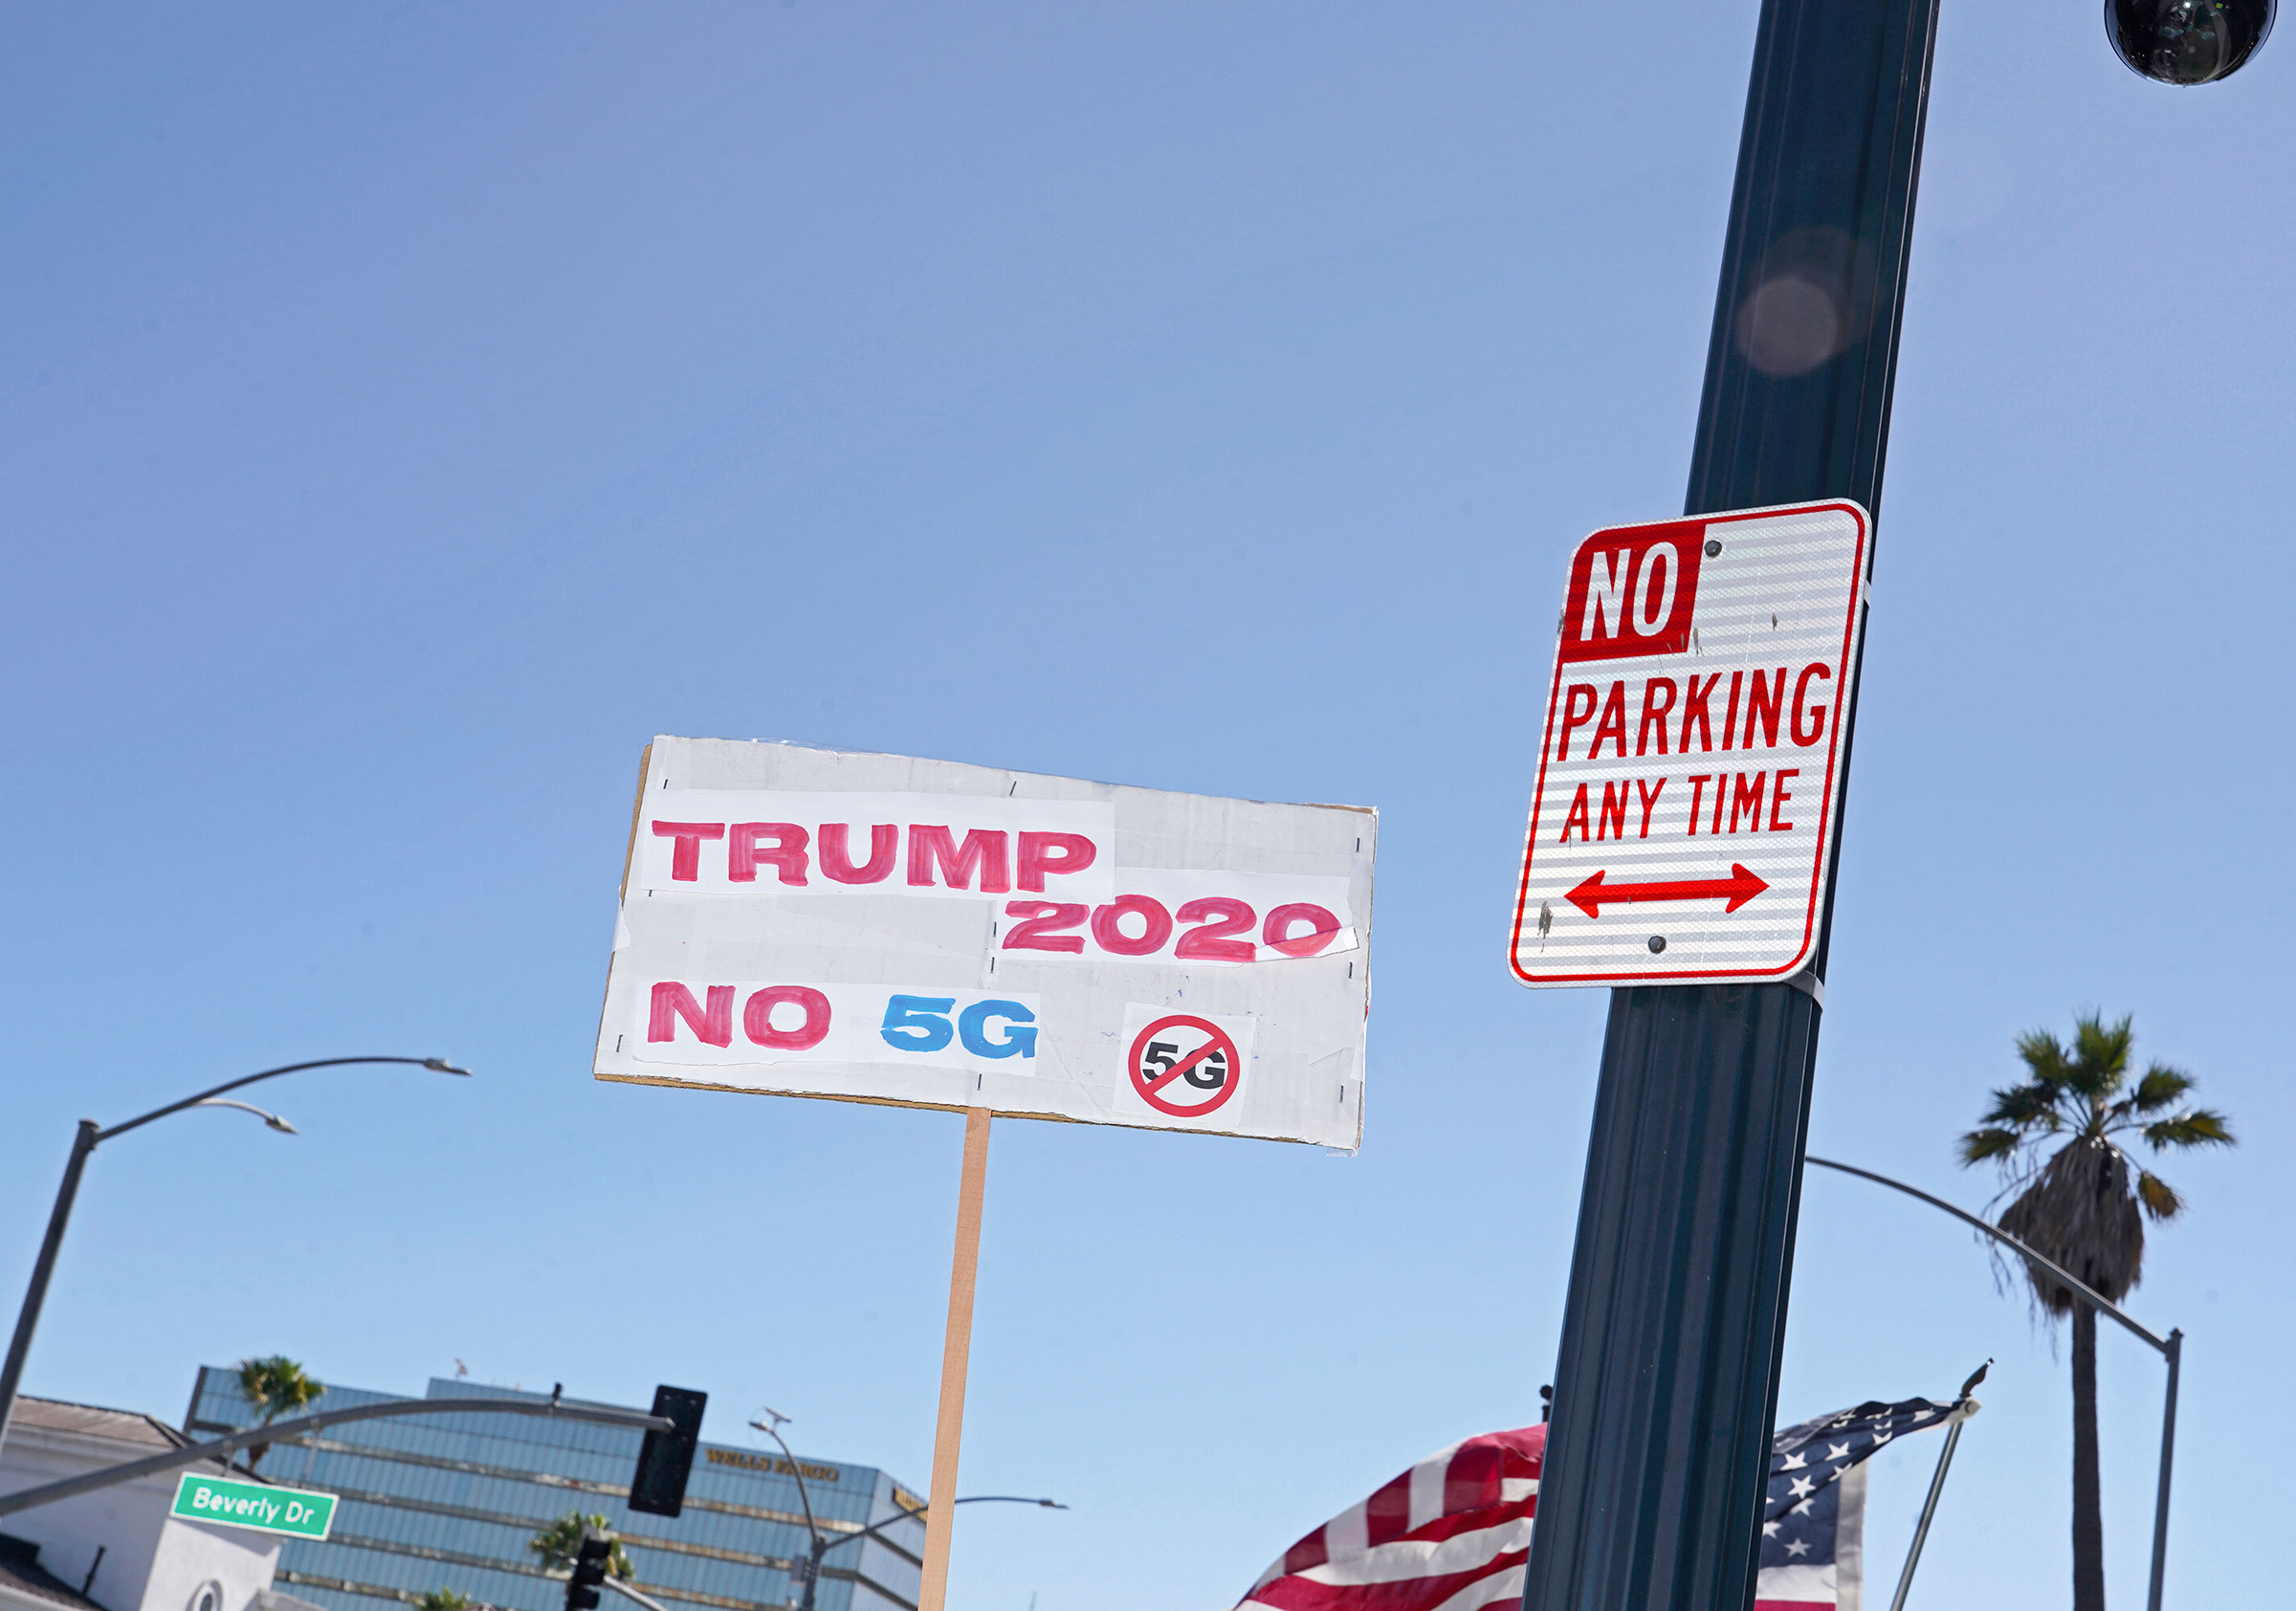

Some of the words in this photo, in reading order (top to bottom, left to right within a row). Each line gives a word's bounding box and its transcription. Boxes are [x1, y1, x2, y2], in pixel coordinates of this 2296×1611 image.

[1579, 541, 1679, 642] NO
[1557, 662, 1831, 761] PARKING
[1558, 777, 1667, 844] ANY
[1687, 768, 1799, 837] TIME
[651, 820, 1097, 894] TRUMP
[1002, 894, 1341, 962] 2020
[648, 981, 832, 1050] NO
[880, 994, 1038, 1059] 5G
[1141, 1042, 1226, 1090] 5G
[706, 1448, 771, 1470] WELLS
[192, 1487, 280, 1524] Beverly
[285, 1501, 315, 1524] Dr
